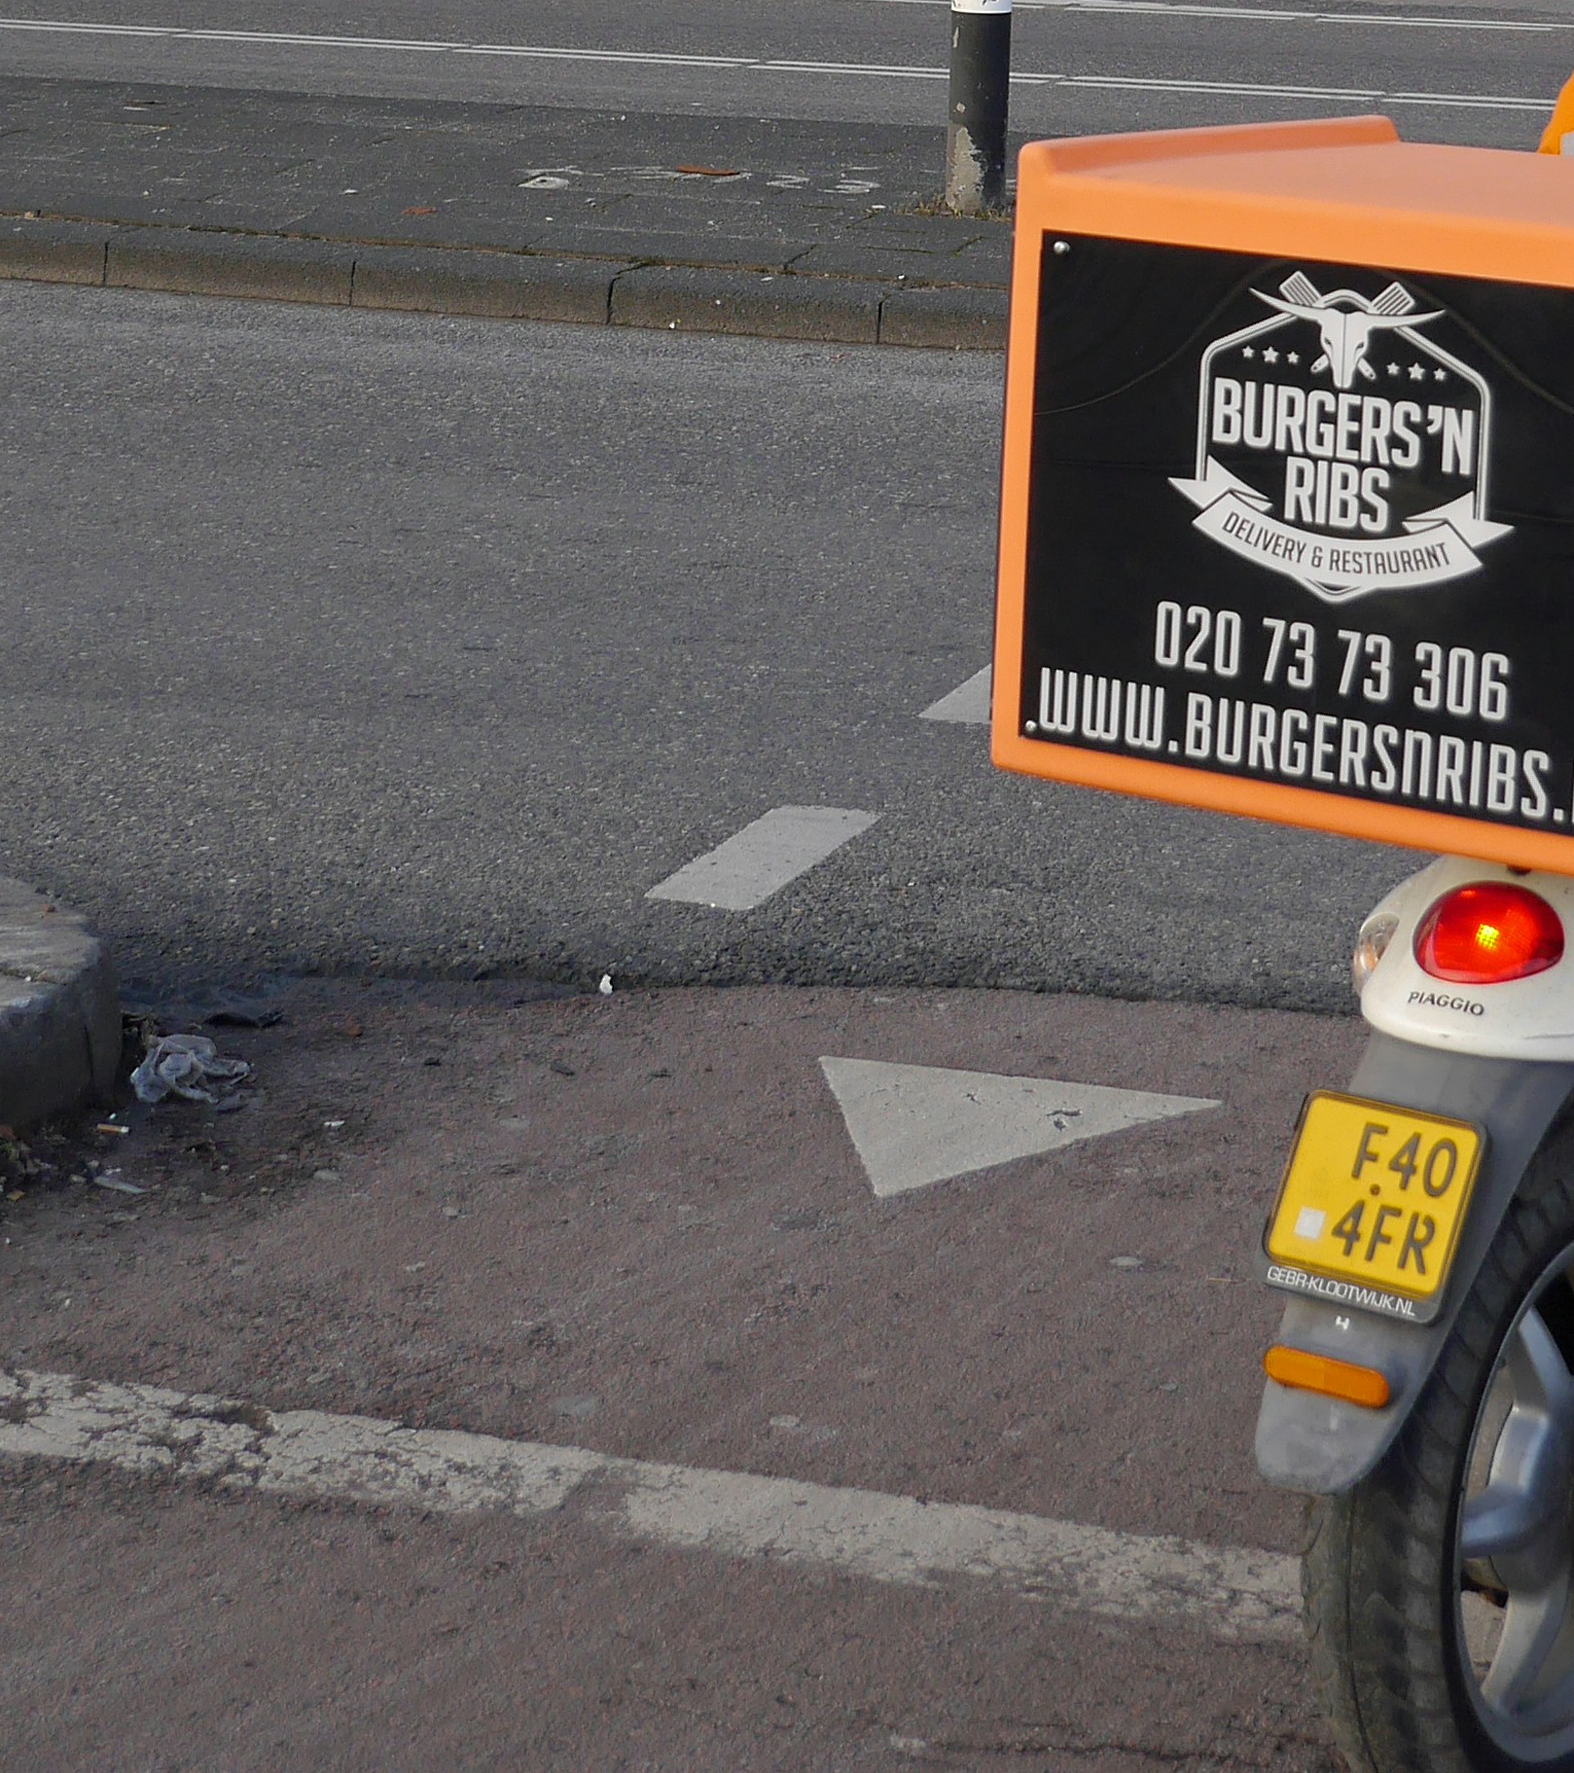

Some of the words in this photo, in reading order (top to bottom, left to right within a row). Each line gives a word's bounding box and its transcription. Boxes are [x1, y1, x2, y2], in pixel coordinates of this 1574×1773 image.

[1284, 455, 1392, 534] RIBS
[1221, 511, 1307, 565] DELIVERY
[1311, 546, 1323, 568] &
[1328, 541, 1452, 575] RESTAURANT
[1154, 600, 1242, 677] 020
[1262, 617, 1316, 688] 73
[1337, 629, 1393, 700] 73
[1413, 641, 1510, 721] 306
[1407, 991, 1486, 1017] PIAGGIO
[1351, 1121, 1458, 1198] F40
[1331, 1199, 1436, 1276] 4FR
